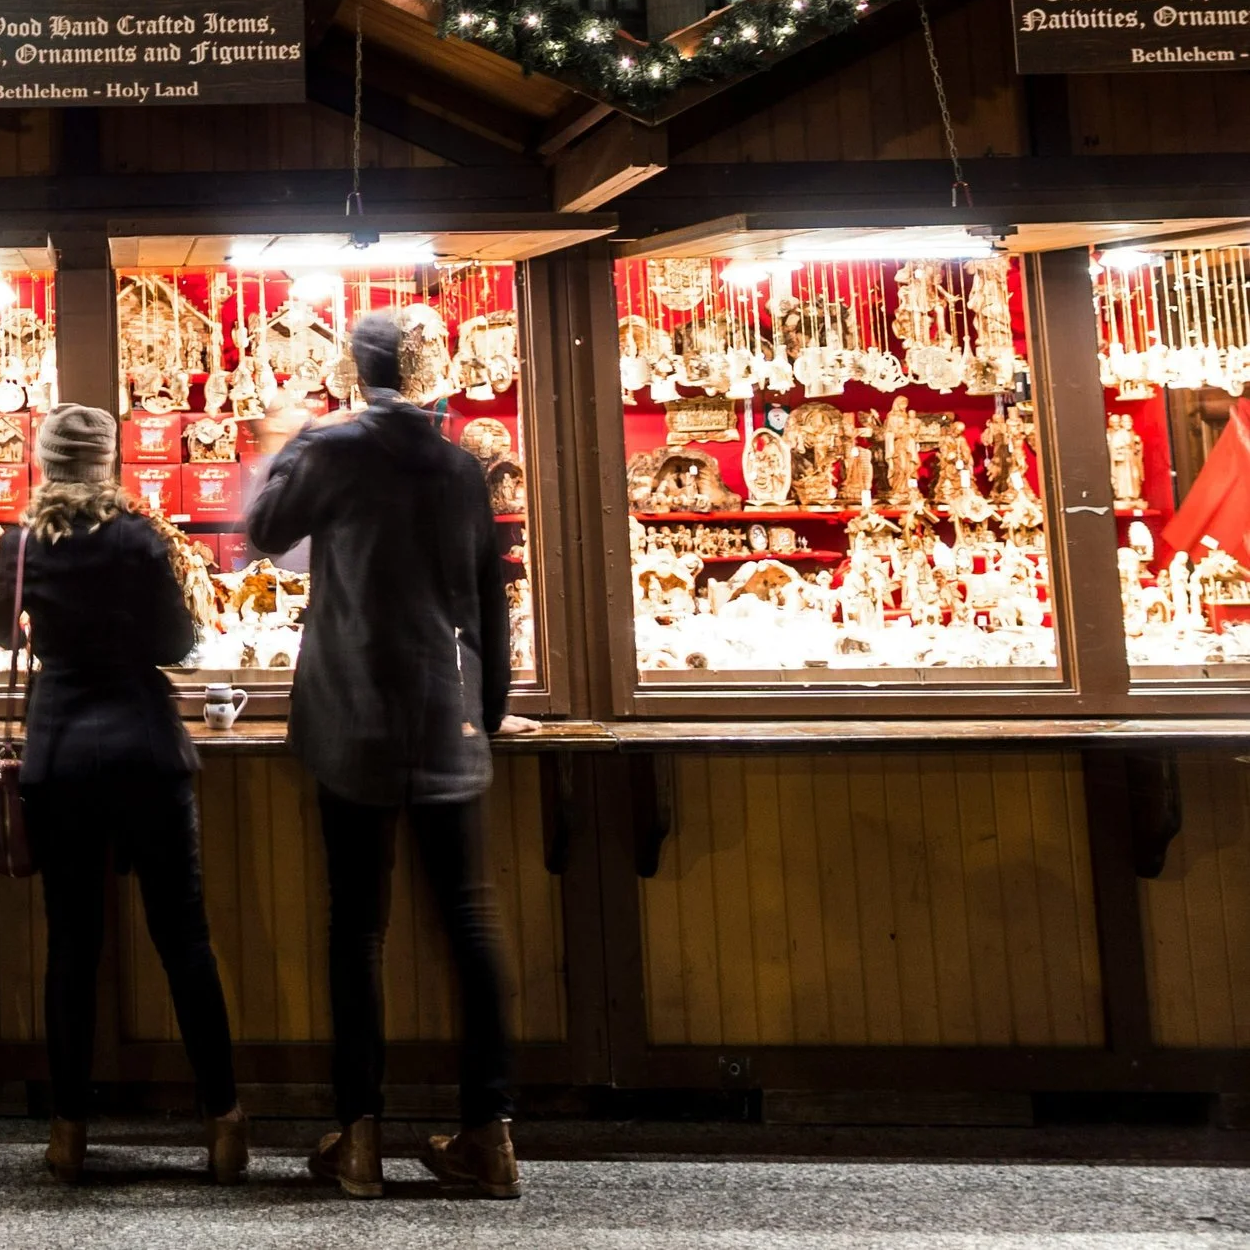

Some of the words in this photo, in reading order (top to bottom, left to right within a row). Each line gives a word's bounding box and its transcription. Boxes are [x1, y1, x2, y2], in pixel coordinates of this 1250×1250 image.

[49, 15, 109, 40] Hand
[116, 15, 196, 35] Crafted
[203, 12, 276, 35] Items,
[1020, 8, 1146, 32] Nativities,
[15, 43, 137, 64] Ornaments
[144, 43, 181, 62] and
[188, 41, 301, 65] Figurines
[1131, 46, 1235, 63] Bethlehem
[106, 82, 150, 103] Holy
[155, 81, 199, 97] Land
